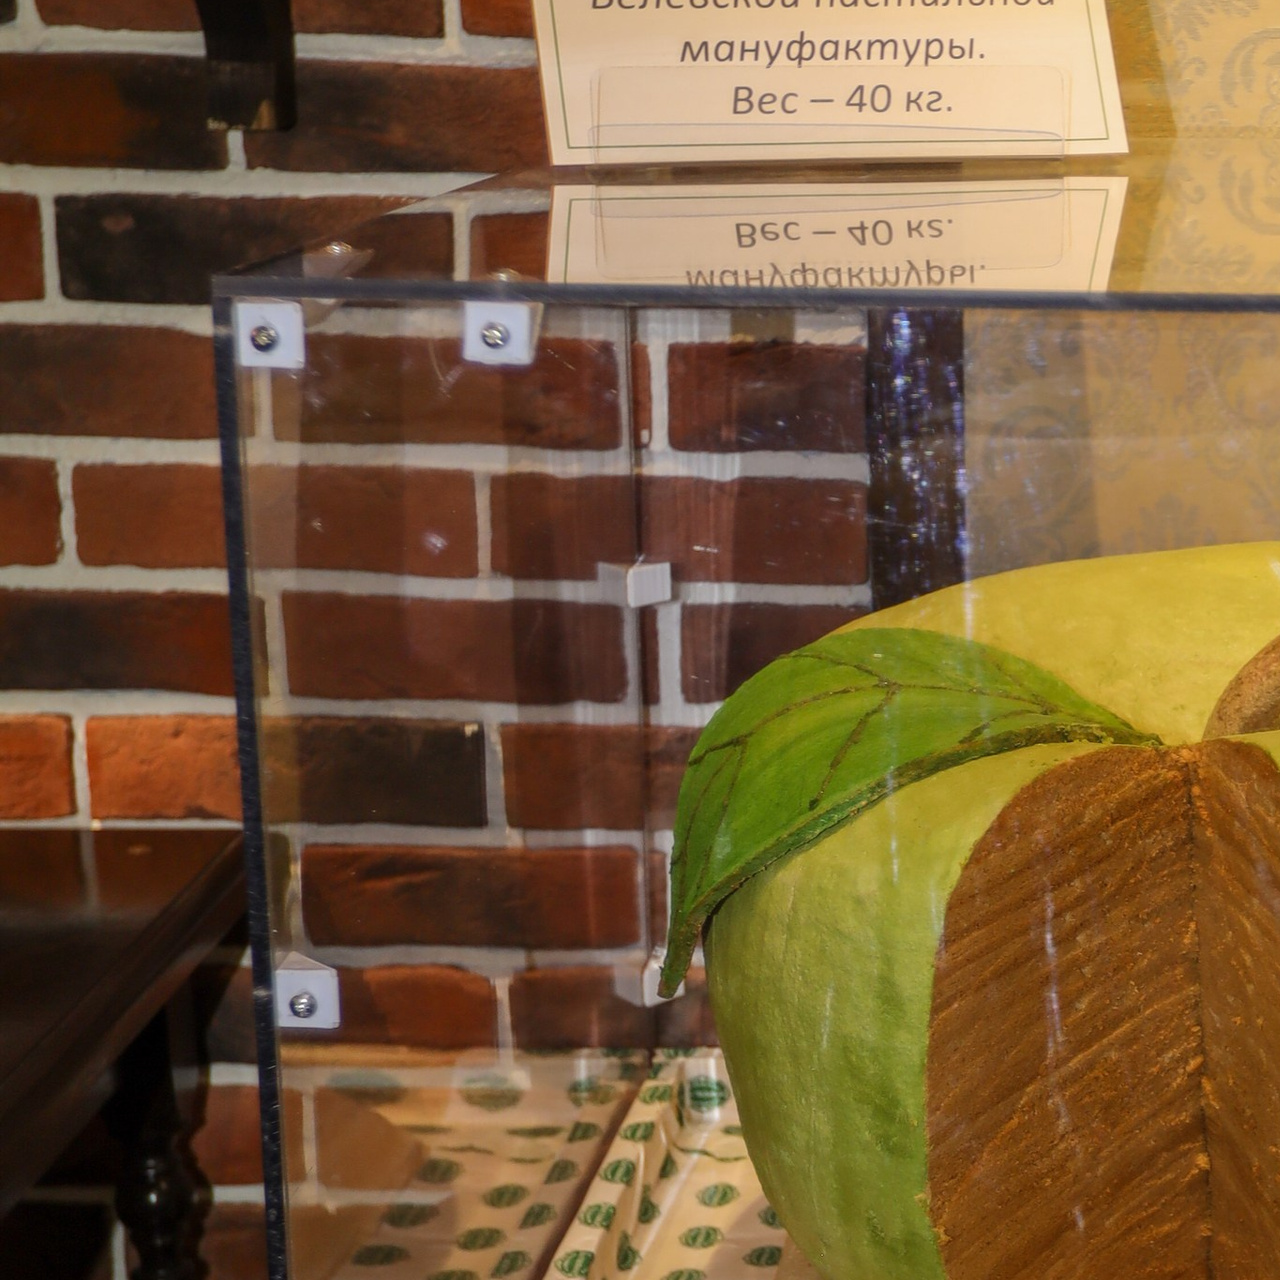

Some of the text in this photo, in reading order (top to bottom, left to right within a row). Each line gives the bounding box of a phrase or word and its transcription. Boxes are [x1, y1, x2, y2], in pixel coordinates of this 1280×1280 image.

[680, 30, 986, 69] мануфактуры.
[732, 85, 799, 115] Вес
[845, 83, 892, 114] 40
[905, 89, 953, 113] кг.
